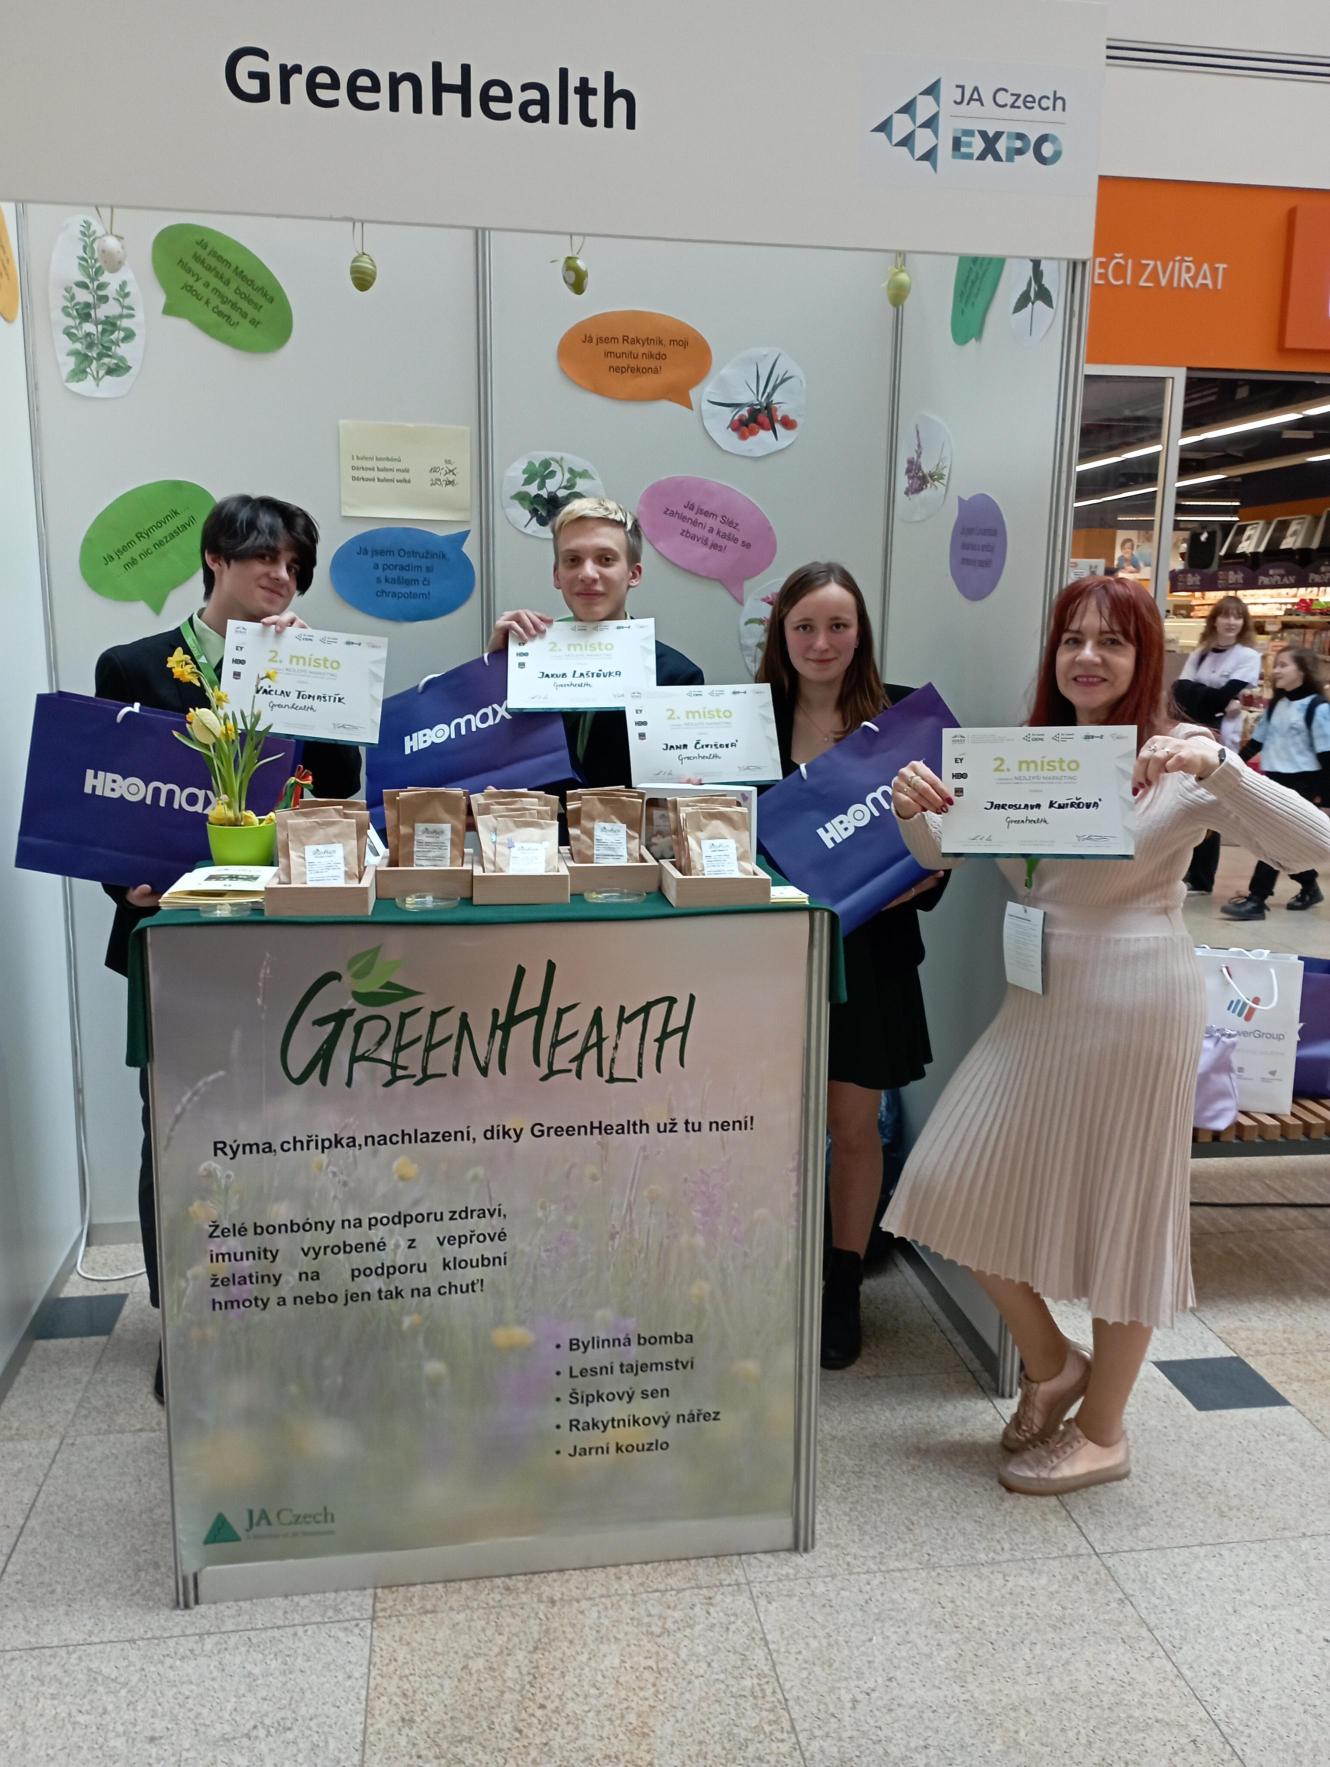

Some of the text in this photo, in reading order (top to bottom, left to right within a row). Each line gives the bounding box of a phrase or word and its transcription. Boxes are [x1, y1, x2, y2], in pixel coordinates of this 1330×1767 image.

[224, 46, 637, 131] GreenHealth
[953, 84, 1067, 112] JA Czech
[951, 128, 1063, 166] EXPO
[207, 248, 232, 270] jsem
[177, 257, 202, 282] hlavy
[203, 280, 211, 289] a
[1138, 255, 1228, 290] ZVÍŘAT
[179, 281, 204, 302] jdou
[204, 297, 212, 309] k
[233, 285, 263, 313] bolest
[582, 334, 593, 344] Já
[596, 335, 619, 346] jsem
[669, 338, 689, 350] moji
[604, 350, 667, 361] imunitu nikdo
[608, 364, 663, 376] nepřekoná!
[683, 500, 695, 512] Já
[696, 506, 718, 521] jsem
[663, 506, 752, 550] zahlenění a kašle se
[102, 553, 115, 566] Já
[114, 538, 137, 560] jsem
[138, 547, 154, 561] nic
[356, 546, 369, 556] Já
[370, 547, 395, 559] jsem
[373, 562, 434, 574] a poradím si
[384, 575, 420, 587] kašlem
[422, 578, 431, 587] či
[375, 589, 431, 602] chrapotem!
[548, 640, 614, 653] 2. místo
[268, 650, 341, 671] 2. místo
[665, 707, 733, 720] 2. místo
[992, 755, 1081, 773] 2. místo
[951, 772, 968, 780] HBO
[483, 1124, 524, 1143] díky
[530, 1119, 650, 1138] GreenHealth
[656, 1118, 678, 1134] už
[684, 1119, 702, 1133] tu
[708, 1116, 755, 1132] není!
[208, 1203, 507, 1239] Želé bonbóny na podporu zdraví,
[210, 1228, 508, 1264] imunity vyrobené z vepřové
[210, 1252, 508, 1288] želatiny na podporu kloubní
[211, 1278, 485, 1311] hmoty a nebo jen tak na chuť!
[568, 1331, 694, 1354] Bylinná bomba
[568, 1356, 695, 1379] Lesní tajemství
[568, 1387, 670, 1407] Šípkový sen
[568, 1408, 721, 1433] Rakytníkový nářez
[568, 1438, 670, 1458] Jarní kouzlo
[245, 1505, 335, 1532] JA Czech
